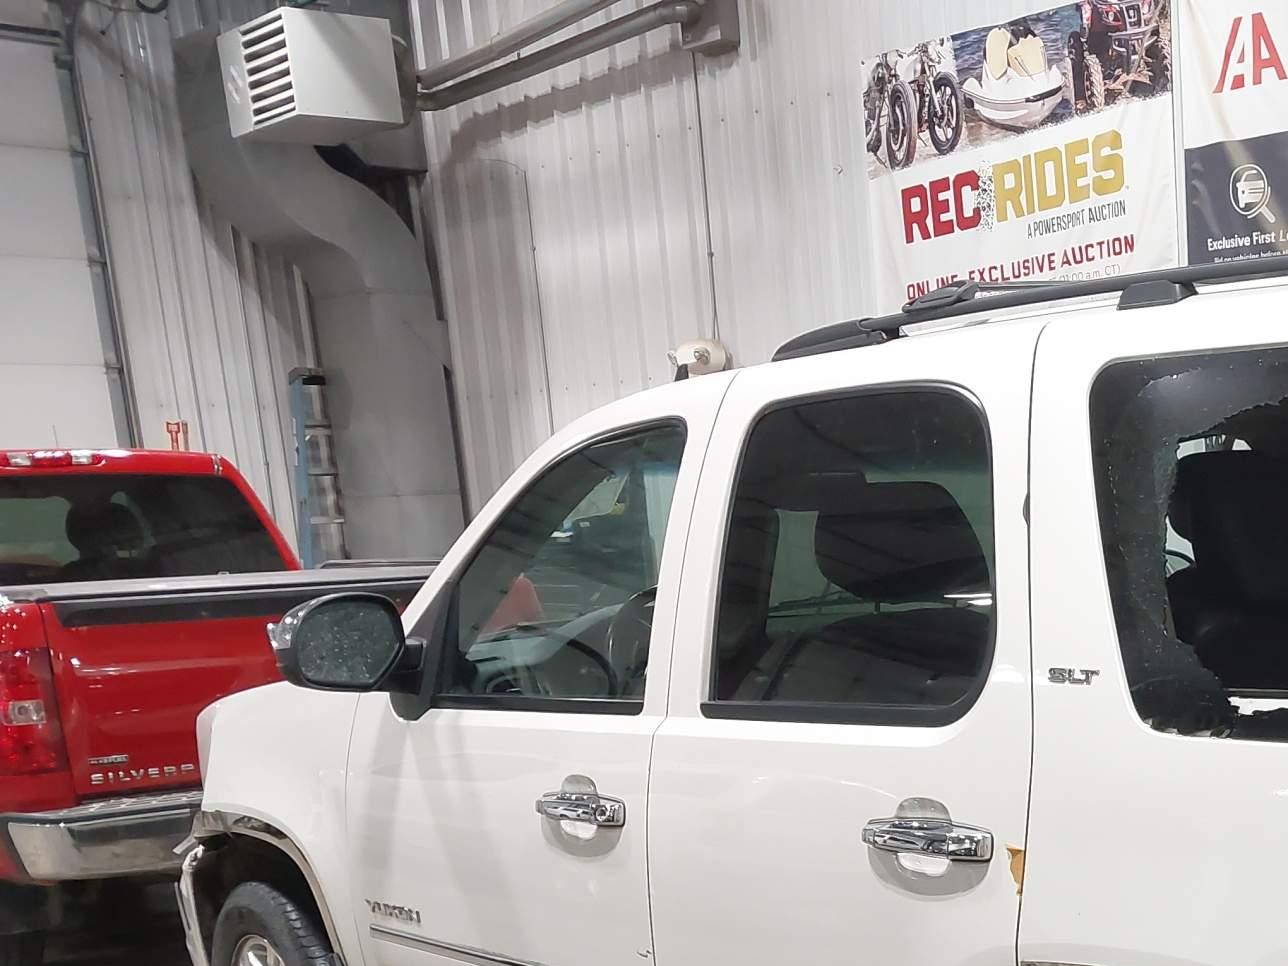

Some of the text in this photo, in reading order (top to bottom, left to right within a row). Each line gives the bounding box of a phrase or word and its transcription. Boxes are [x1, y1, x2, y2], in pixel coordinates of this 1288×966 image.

[901, 129, 1125, 244] REC RIDES
[1027, 199, 1126, 240] A POWERSPORT AUCTION
[968, 252, 1056, 283] EXCLUSIVE
[1061, 234, 1135, 268] AUCTION
[1207, 234, 1251, 251] Exclusive
[1252, 231, 1276, 246] First
[1047, 667, 1100, 685] SLT
